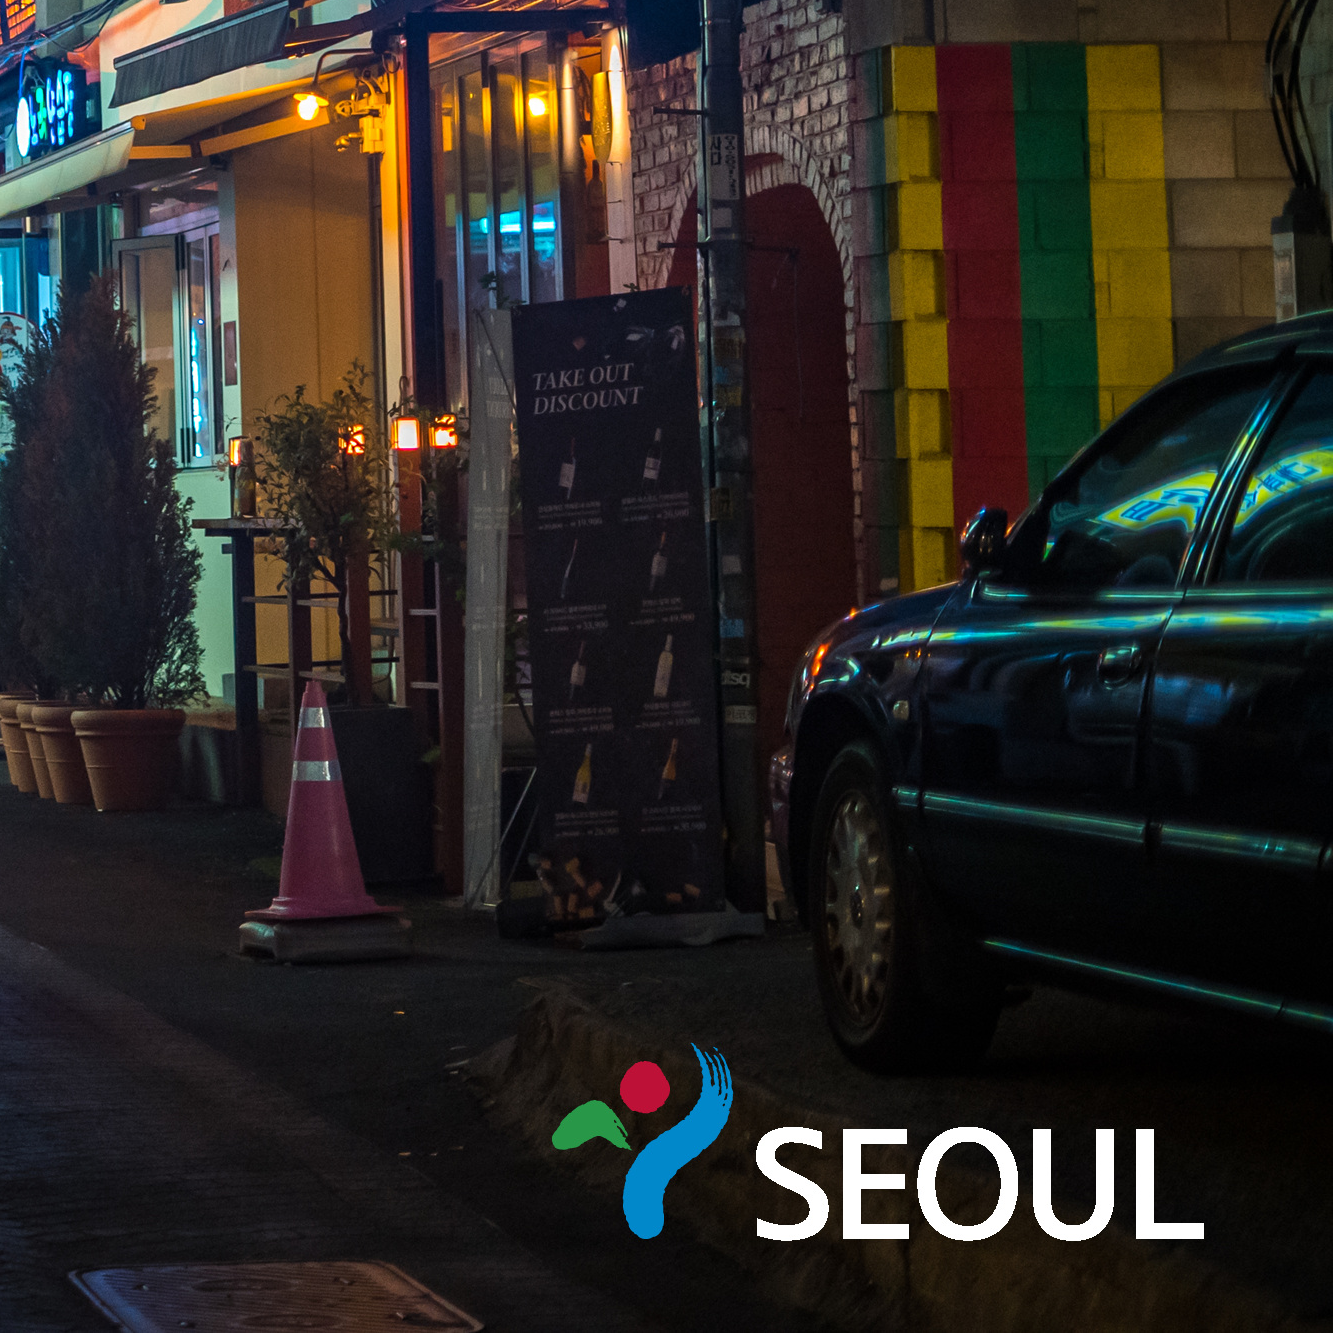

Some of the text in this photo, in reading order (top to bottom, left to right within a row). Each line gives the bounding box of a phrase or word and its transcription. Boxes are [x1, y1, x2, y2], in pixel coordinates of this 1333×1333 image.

[532, 362, 635, 392] TAKE OUT
[533, 386, 645, 415] DISCOUNT
